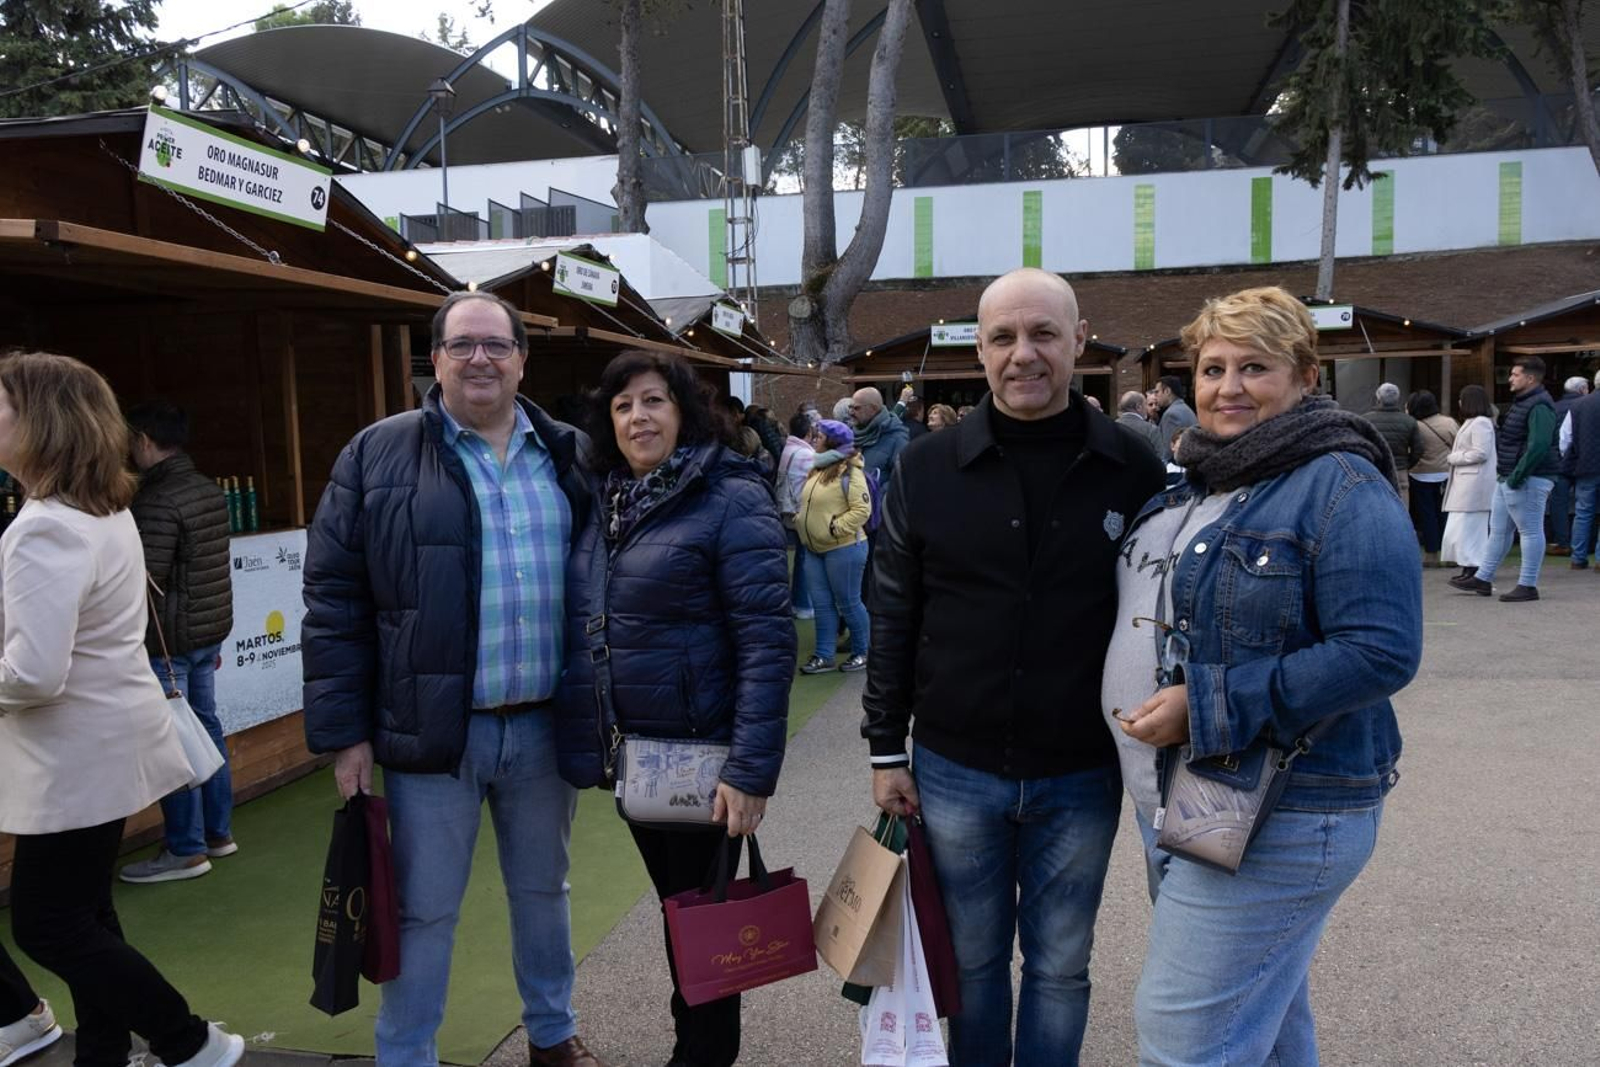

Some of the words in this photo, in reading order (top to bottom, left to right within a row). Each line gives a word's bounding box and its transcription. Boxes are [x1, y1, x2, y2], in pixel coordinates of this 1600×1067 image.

[147, 138, 182, 159] ACEITE
[207, 145, 226, 163] ORO
[227, 151, 279, 180] MAGNASUR
[198, 165, 236, 190] BEDMAR
[238, 178, 245, 192] Y
[245, 181, 283, 203] GARCIEZ
[312, 188, 325, 207] 74
[237, 652, 255, 667] 8-9
